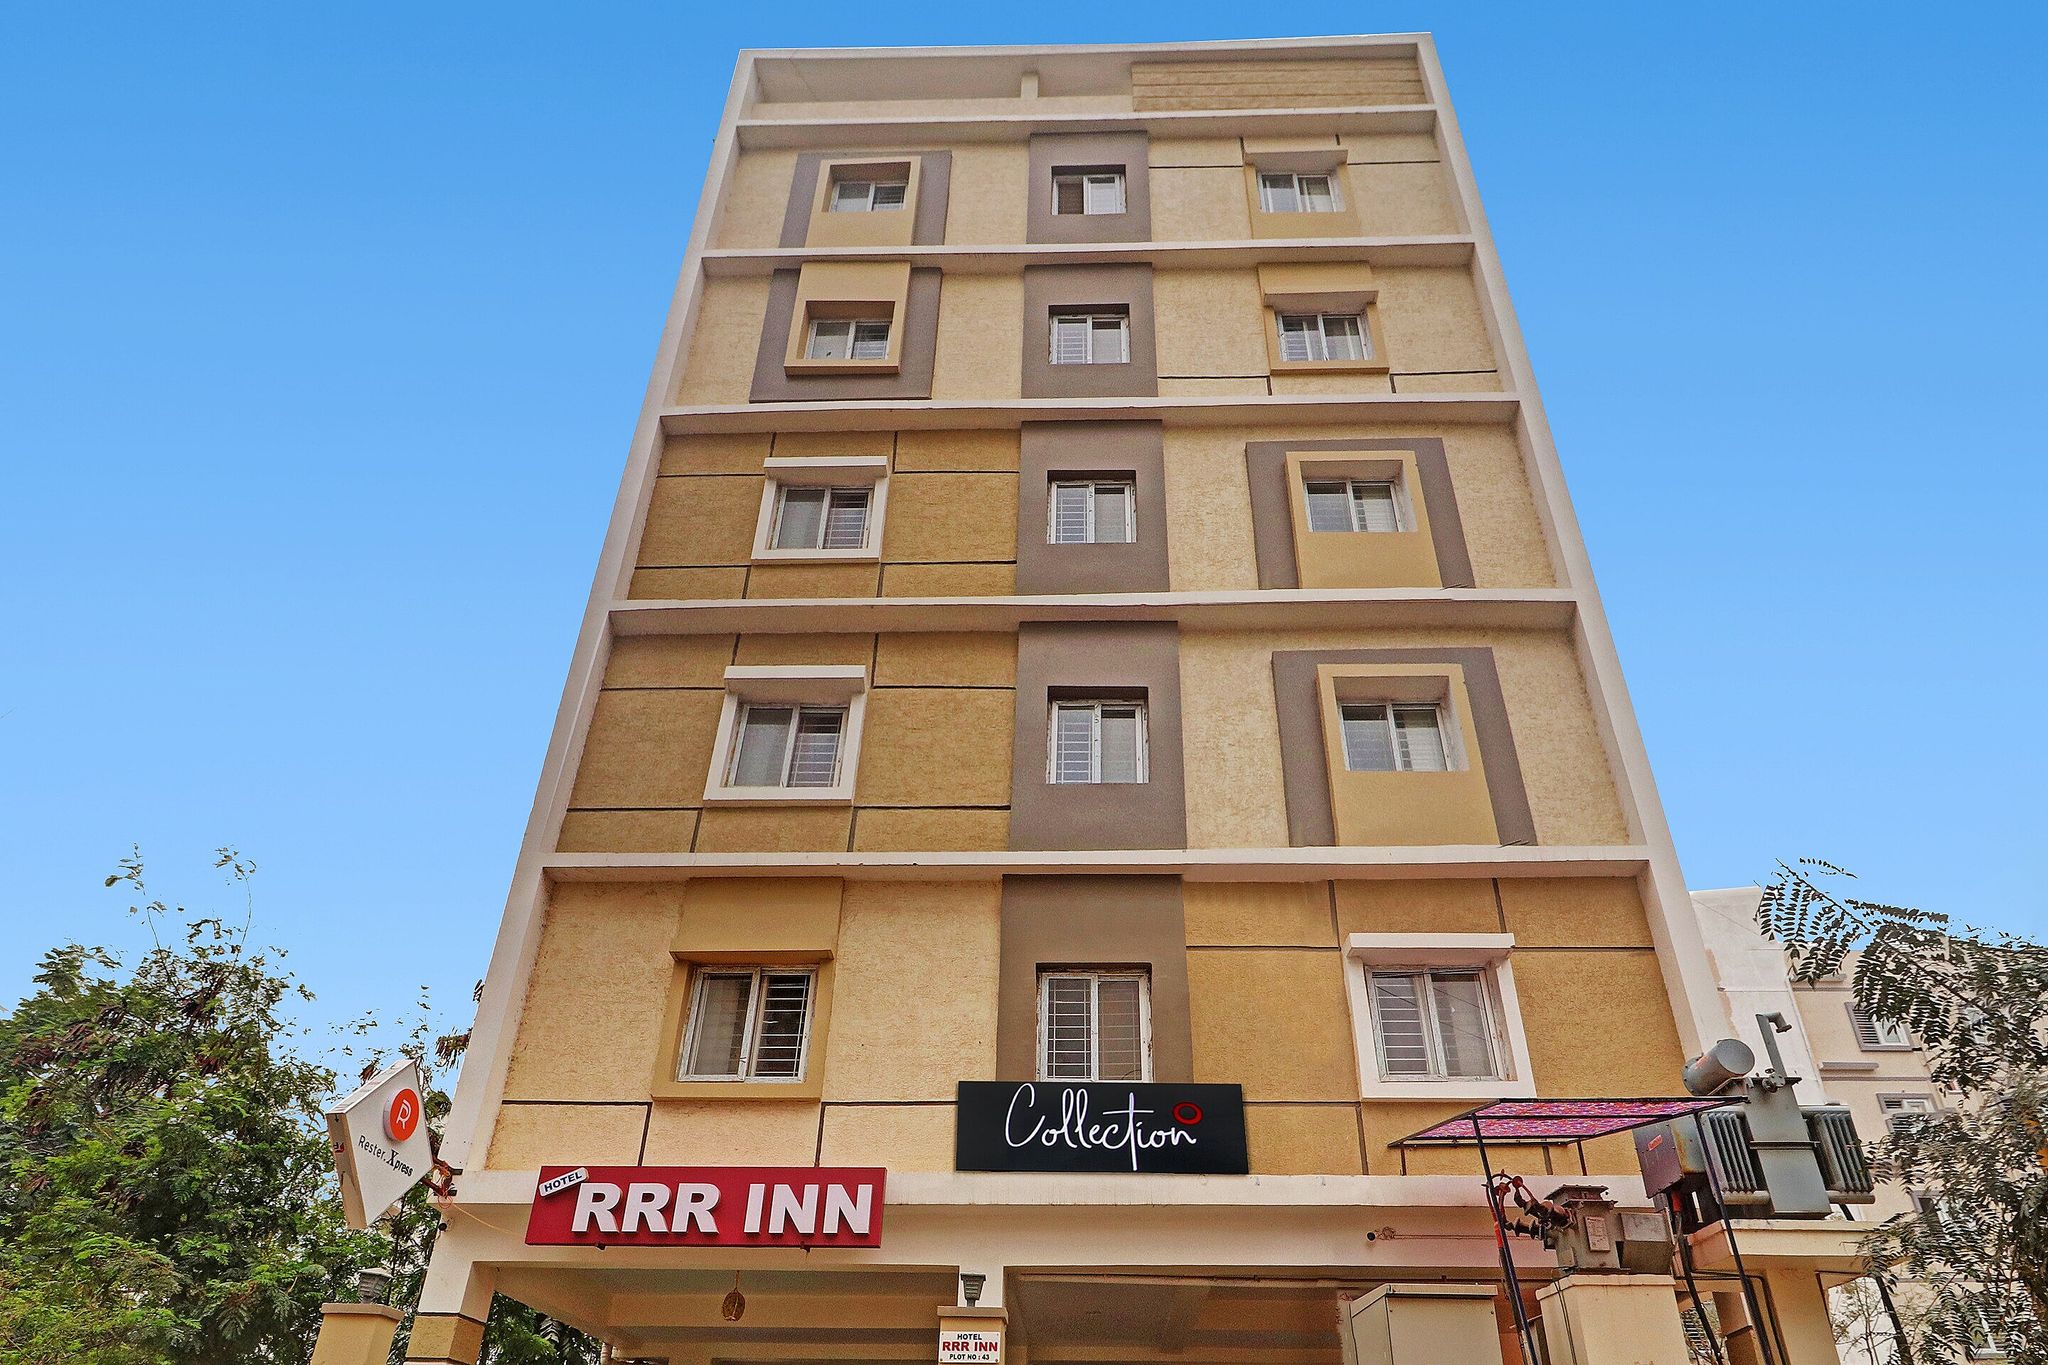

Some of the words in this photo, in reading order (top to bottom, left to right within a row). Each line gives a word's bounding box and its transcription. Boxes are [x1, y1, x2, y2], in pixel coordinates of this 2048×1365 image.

[1005, 1083, 1197, 1171] Collection
[543, 1170, 583, 1194] HOTEL
[571, 1182, 721, 1234] RRR
[743, 1183, 873, 1235] INN
[942, 1341, 970, 1351] RRR
[974, 1341, 998, 1351] INN
